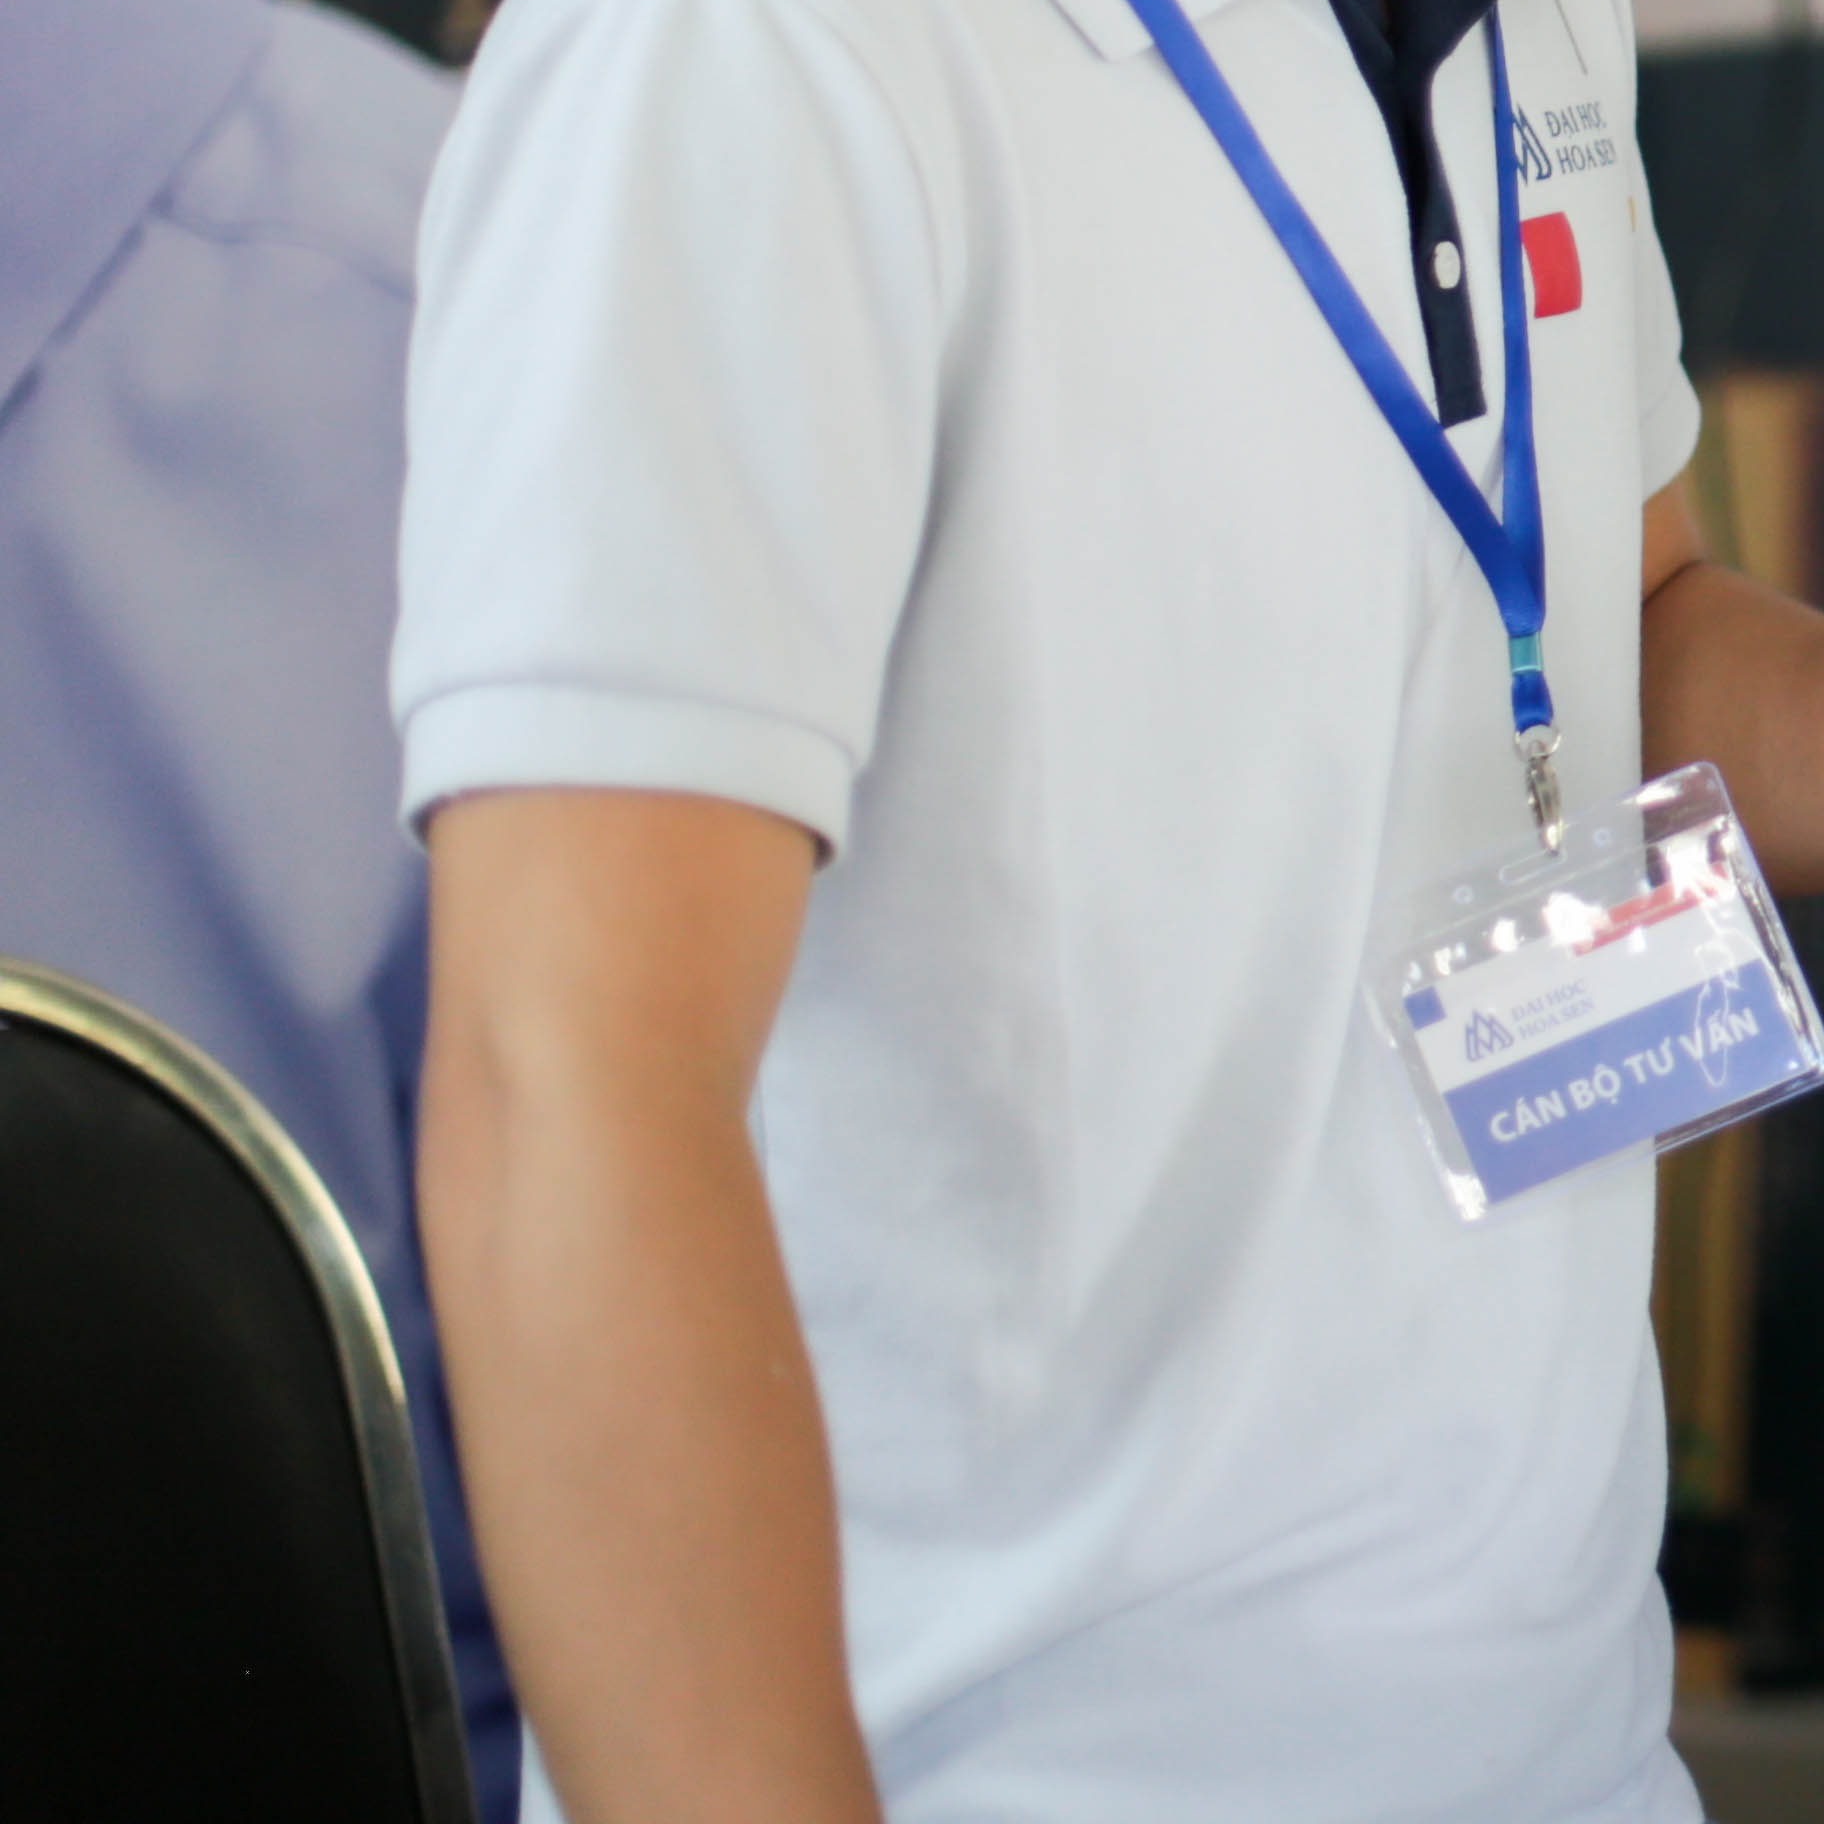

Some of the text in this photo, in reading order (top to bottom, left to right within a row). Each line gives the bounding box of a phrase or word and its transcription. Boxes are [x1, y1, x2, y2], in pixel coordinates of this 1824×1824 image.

[1489, 1088, 1568, 1143] CÁN
[1567, 1061, 1623, 1113] BỘ
[1622, 1034, 1676, 1085] TƯ
